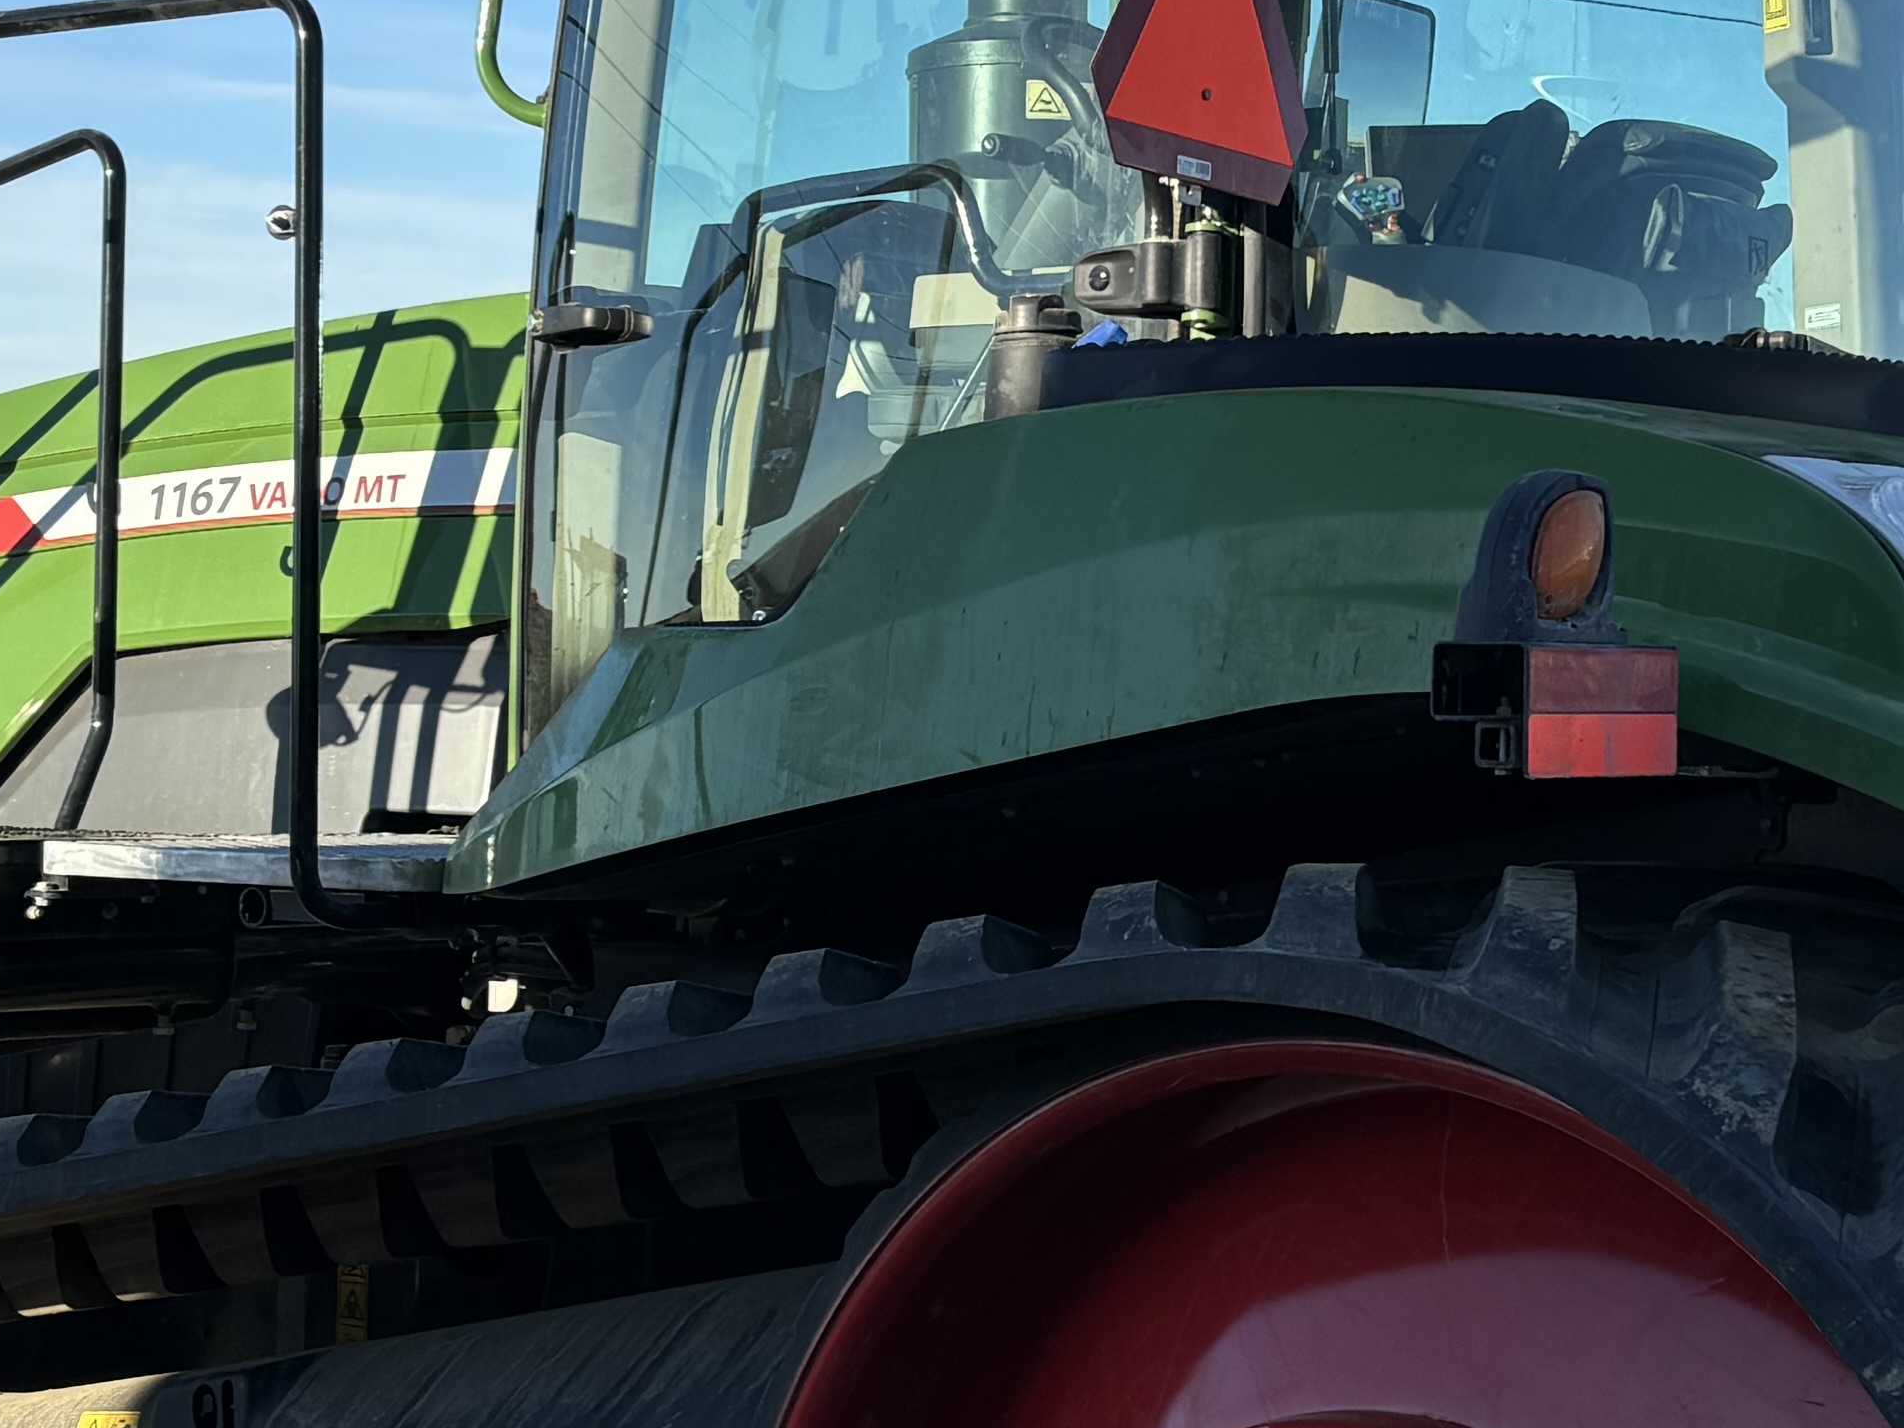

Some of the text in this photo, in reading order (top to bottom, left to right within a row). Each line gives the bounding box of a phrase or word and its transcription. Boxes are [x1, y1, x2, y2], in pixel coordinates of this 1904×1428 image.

[150, 474, 406, 521] 1167 VAO MT
